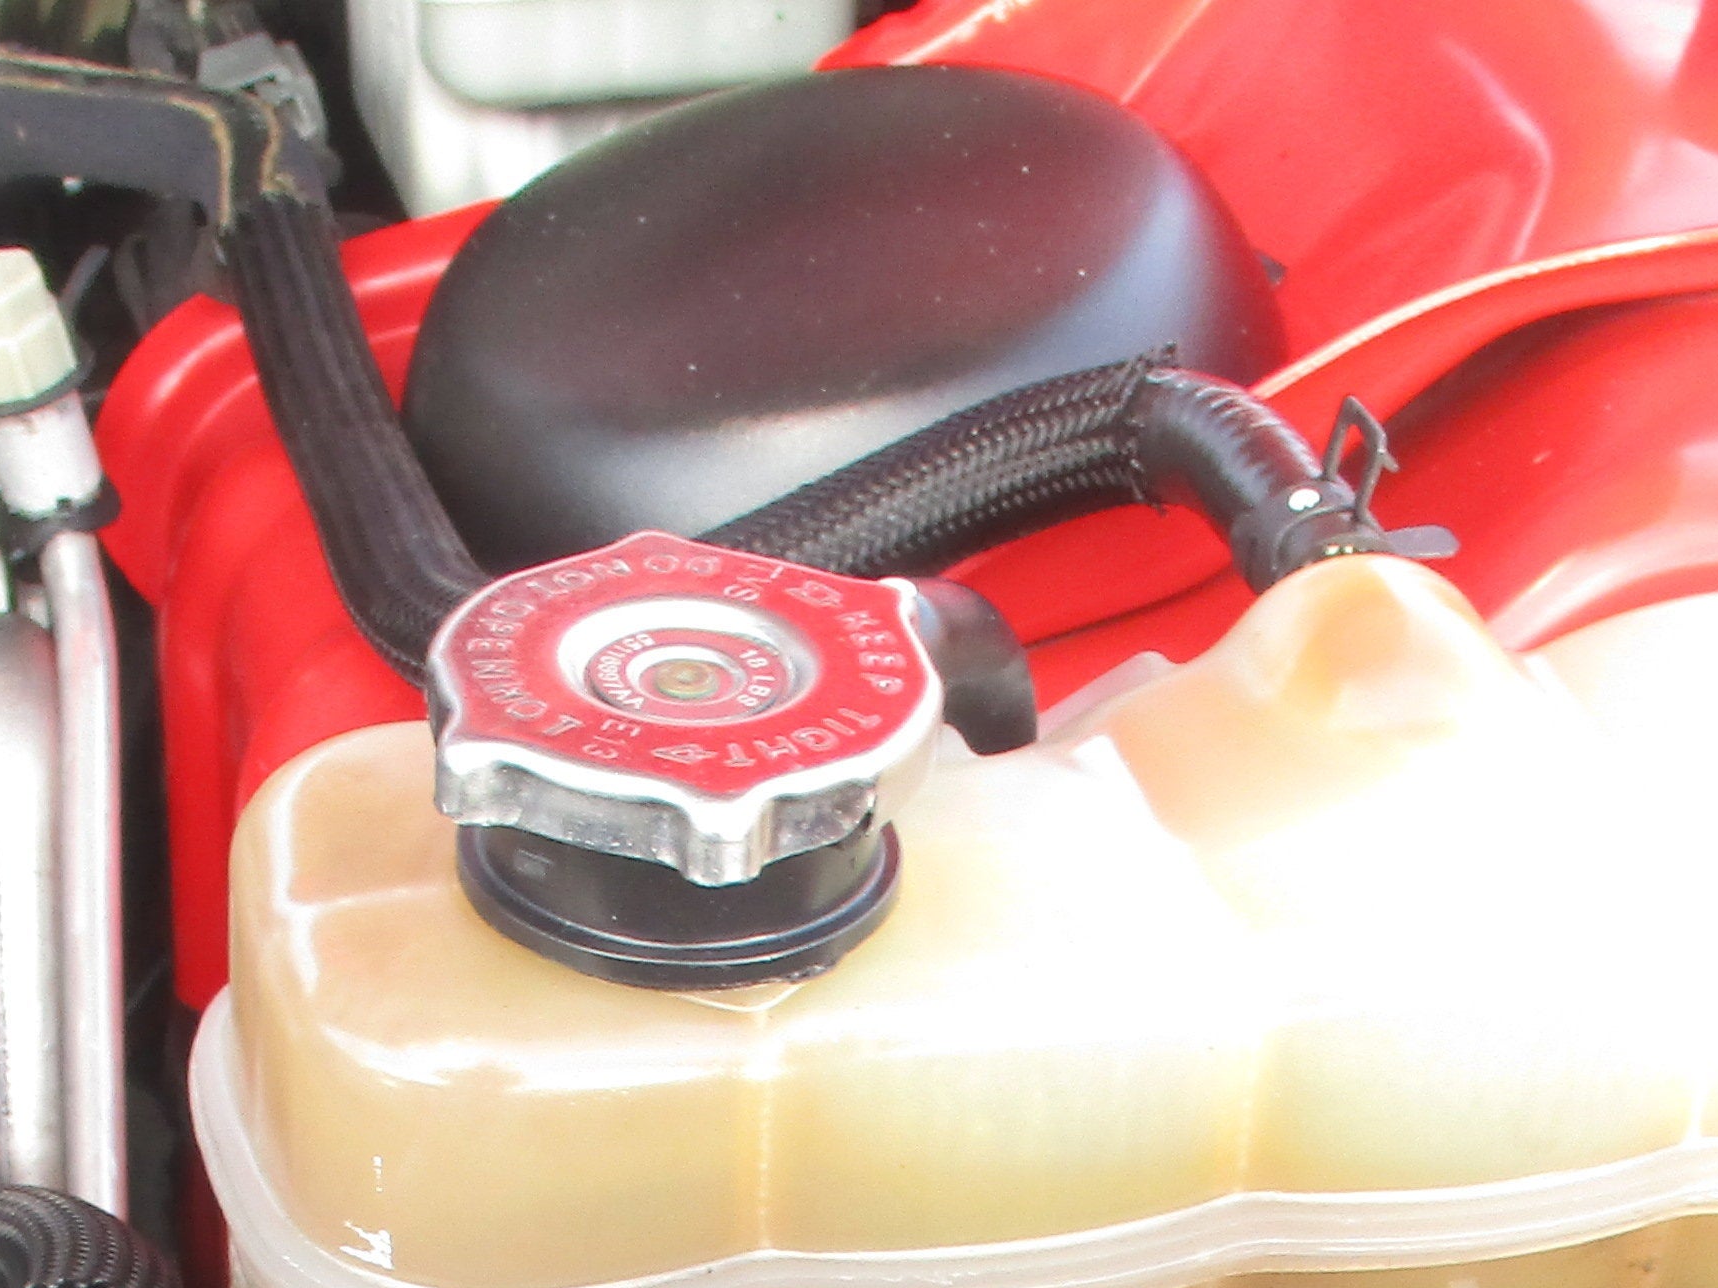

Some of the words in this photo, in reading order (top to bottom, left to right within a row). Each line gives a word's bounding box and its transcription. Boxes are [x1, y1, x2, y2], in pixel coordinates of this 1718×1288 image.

[525, 558, 633, 598] NOT
[643, 553, 722, 577] DO
[466, 600, 537, 680] OPEN
[738, 648, 771, 669] 18
[835, 609, 908, 695] KEEP
[482, 681, 585, 736] HOT
[736, 674, 777, 708] LBS
[722, 706, 883, 768] TIGHT
